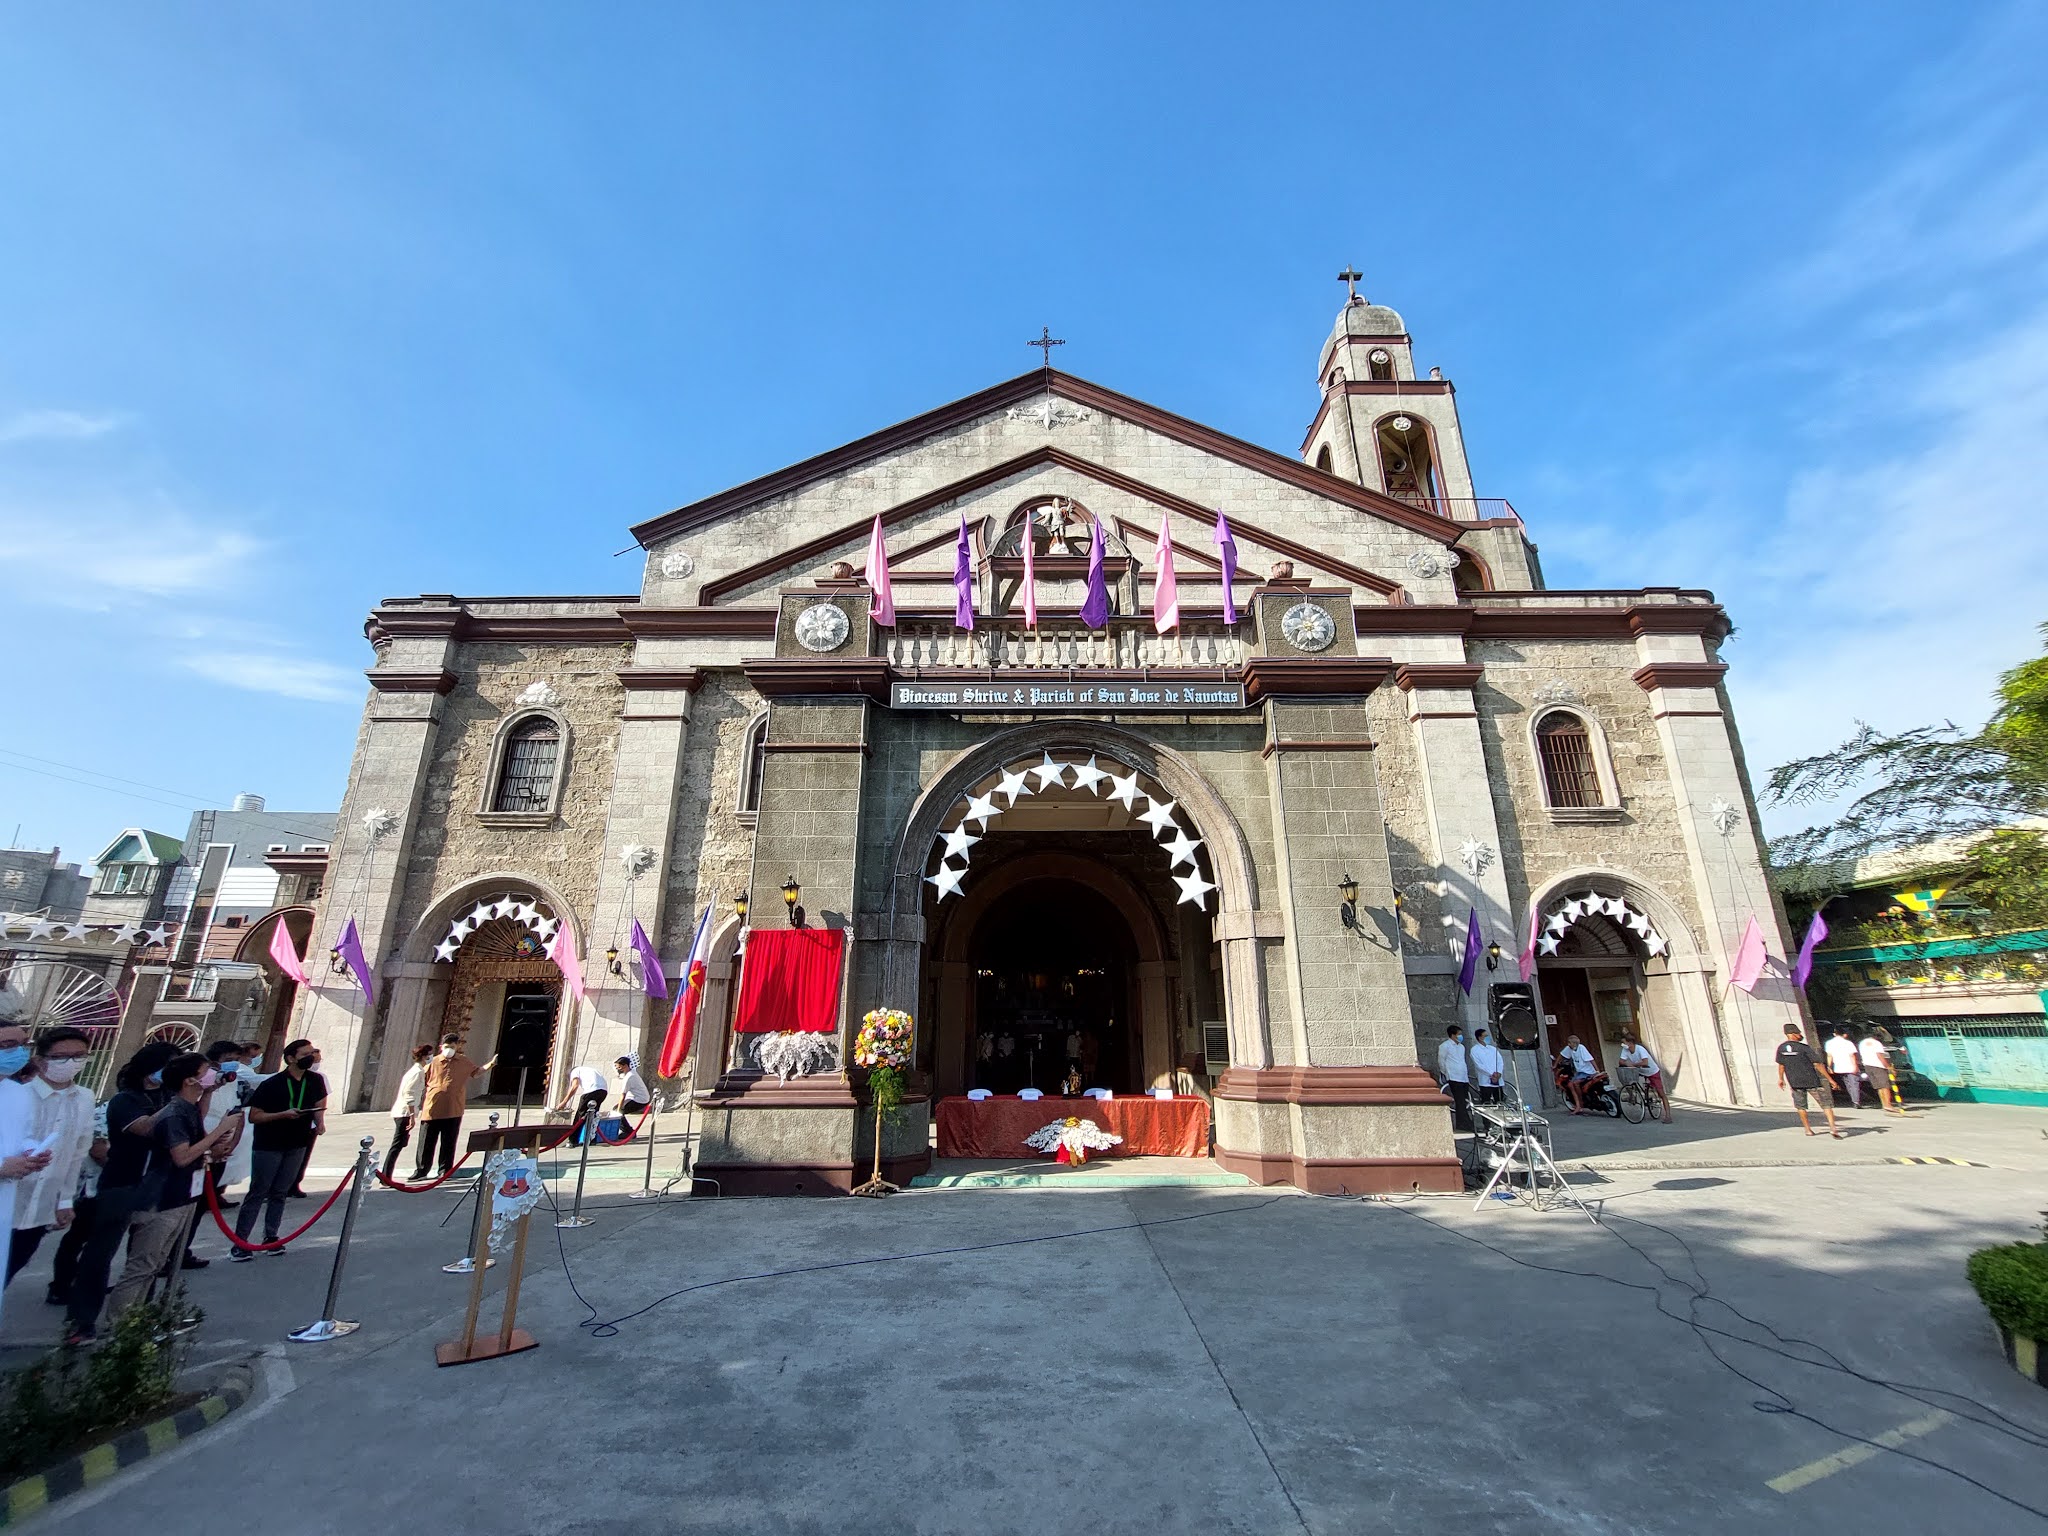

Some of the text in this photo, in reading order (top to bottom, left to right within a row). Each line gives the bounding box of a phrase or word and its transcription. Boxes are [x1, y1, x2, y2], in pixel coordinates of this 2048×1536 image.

[899, 687, 1238, 706] Diocesan Shrine & Parish of San Jose de Navotas
